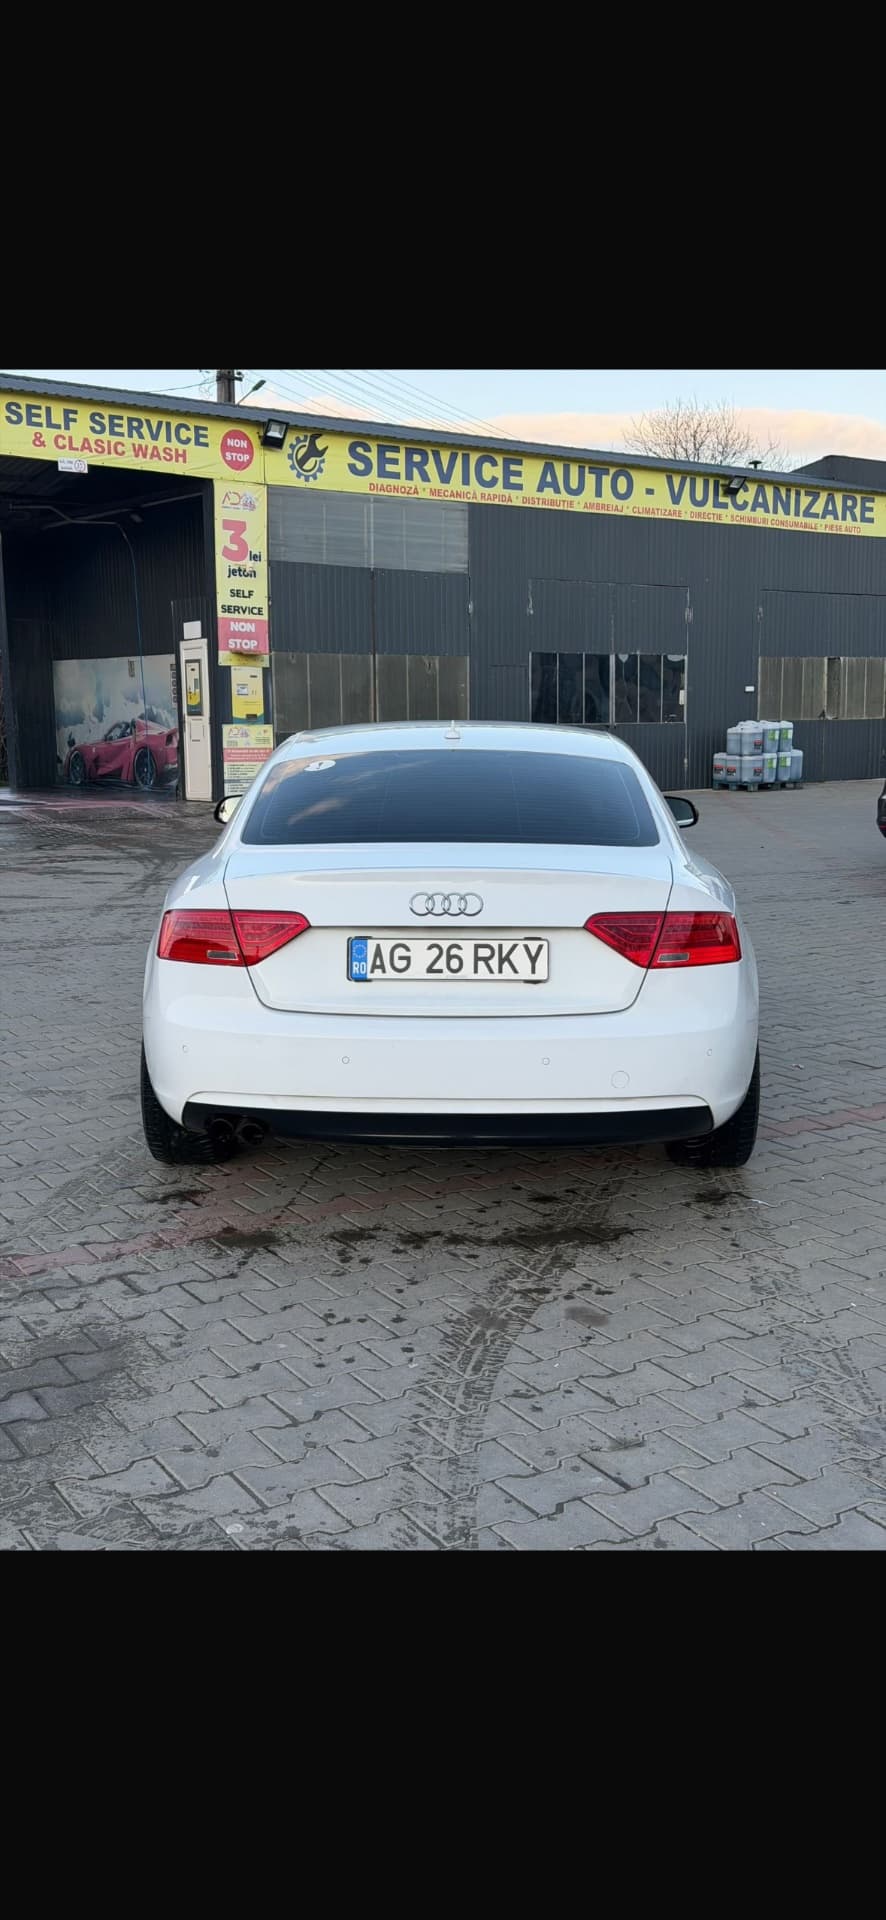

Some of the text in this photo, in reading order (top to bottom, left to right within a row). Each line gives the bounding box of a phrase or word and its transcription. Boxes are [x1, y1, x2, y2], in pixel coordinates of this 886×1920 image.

[5, 401, 209, 448] SELF SERVICE
[32, 432, 187, 464] & CLASIC WASH
[226, 437, 248, 449] NON
[225, 451, 250, 463] STOP
[347, 440, 524, 491] SERVICE
[537, 461, 634, 502] AUTO
[666, 474, 875, 524] VULCANIZARE
[583, 501, 624, 514] AMBREIAJ
[631, 506, 683, 519] CLIMATIZARE
[730, 513, 769, 526] SCHIMBURI
[771, 518, 818, 531] CONSUMABILE
[824, 523, 843, 533] PIESE
[844, 525, 862, 534] AUTO
[221, 518, 262, 563] 3 lei
[227, 564, 257, 579] jeton
[229, 588, 254, 599] SELF
[221, 604, 264, 616] SERVICE
[229, 621, 256, 633] NON
[228, 638, 258, 650] STOP
[369, 943, 545, 975] AG 26 RKY
[352, 961, 366, 974] RO
